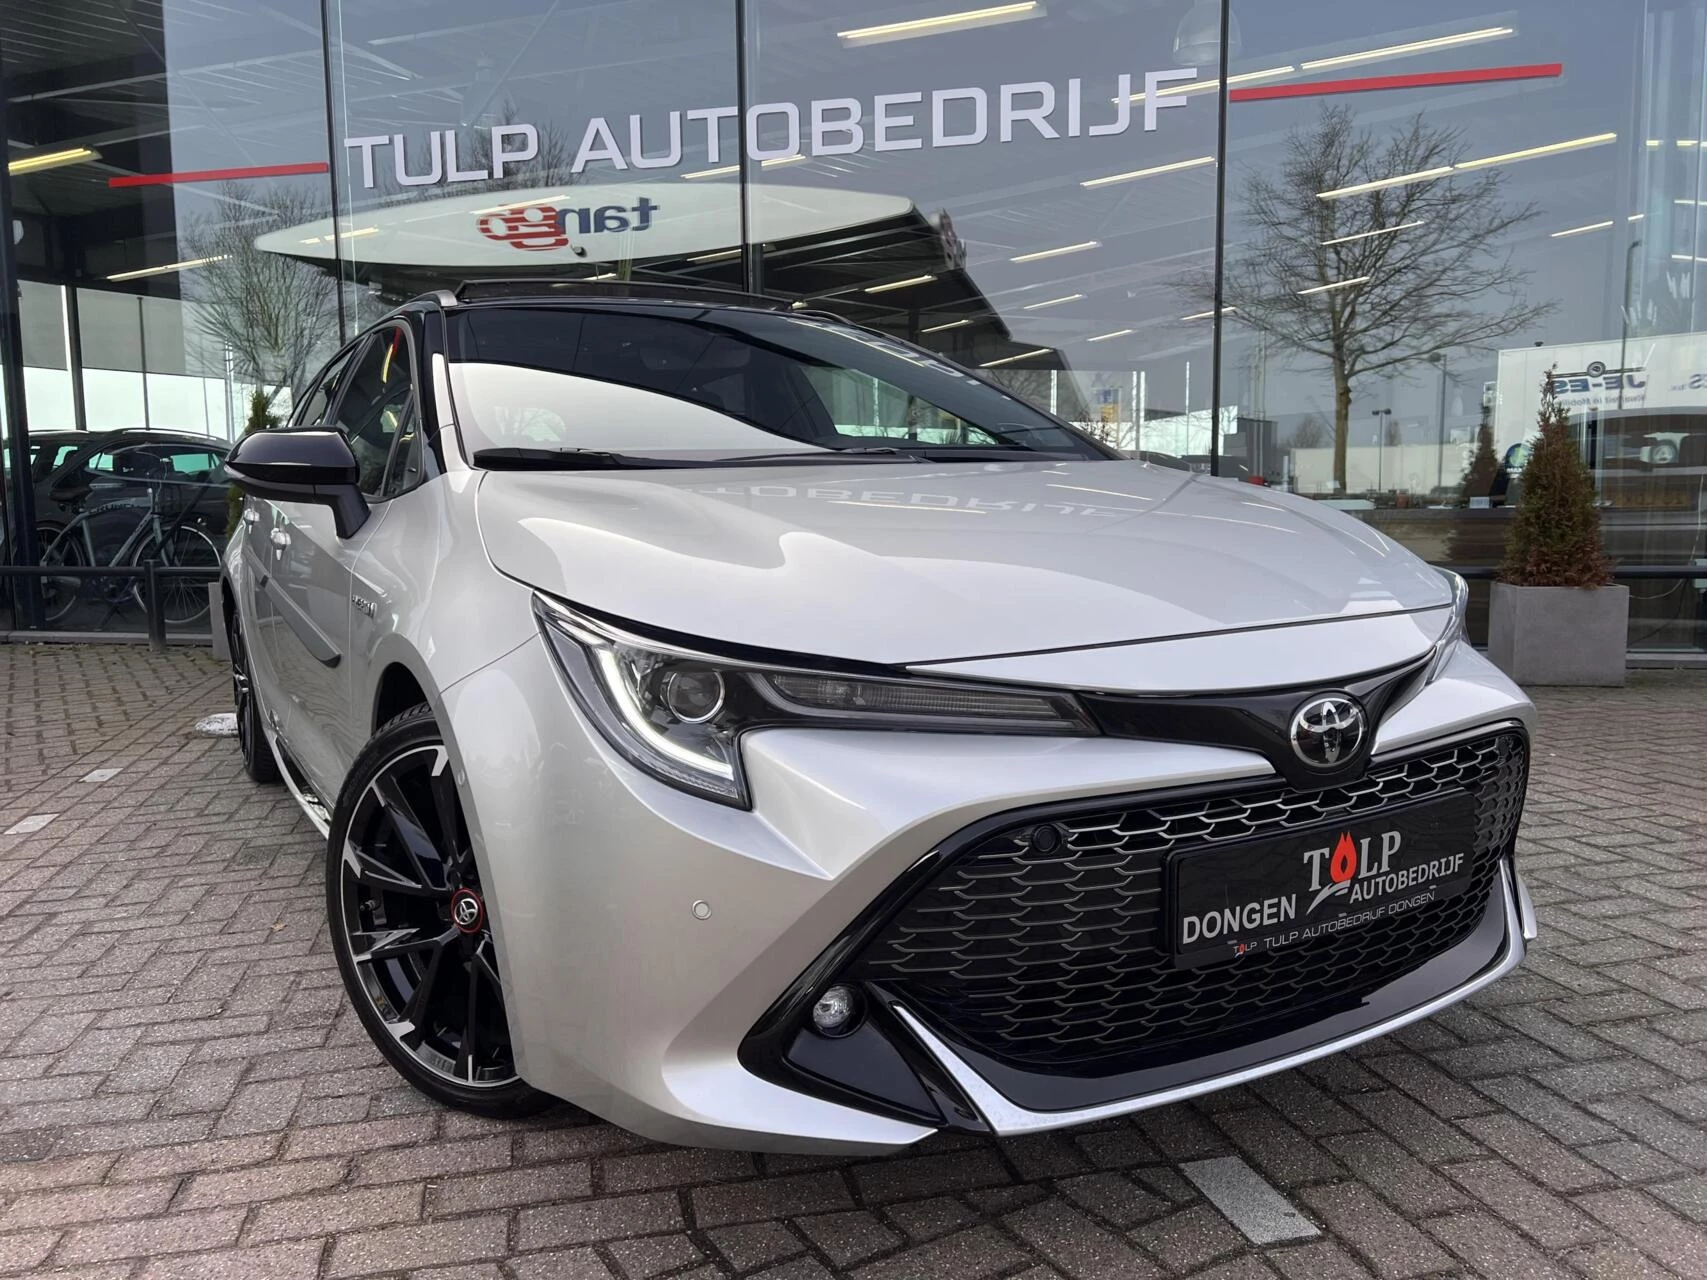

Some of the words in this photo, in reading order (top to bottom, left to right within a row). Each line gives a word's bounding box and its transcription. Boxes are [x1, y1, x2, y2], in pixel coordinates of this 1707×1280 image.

[346, 123, 540, 188] TULP
[571, 67, 1198, 175] AUTOBEDRIJF
[1182, 894, 1297, 945] DONGEN
[1349, 853, 1465, 904] AUTOBEDRIJF
[1264, 931, 1299, 949] TULP
[1302, 907, 1386, 939] AUTOBEDRIJF
[1389, 890, 1436, 915] DONGEN
